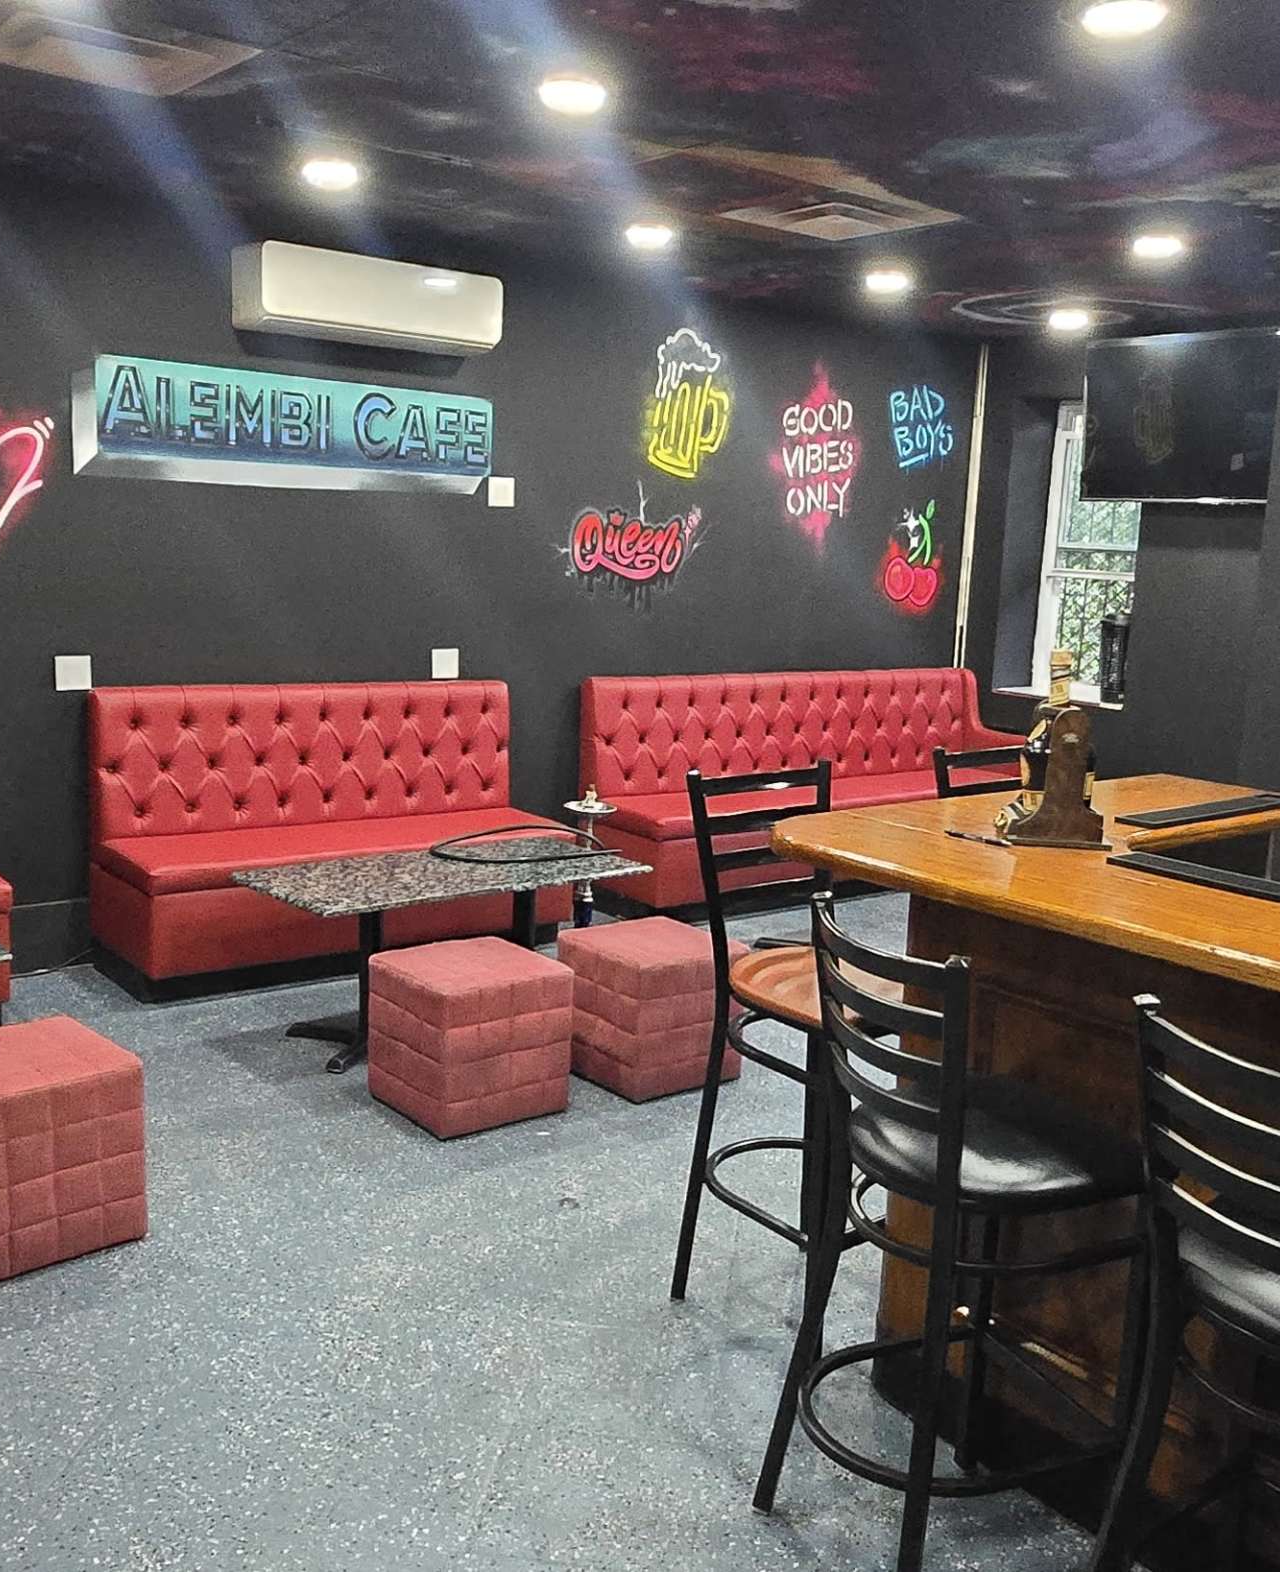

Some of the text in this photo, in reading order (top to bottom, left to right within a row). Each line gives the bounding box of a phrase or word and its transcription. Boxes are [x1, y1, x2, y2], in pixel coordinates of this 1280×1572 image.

[102, 364, 489, 467] ALEMBI CAFE
[782, 399, 854, 436] GOOD
[889, 384, 945, 422] BAD
[893, 419, 954, 458] BOYS
[782, 440, 854, 478] VIBES
[785, 478, 852, 518] ONLY
[573, 511, 683, 582] Queen
